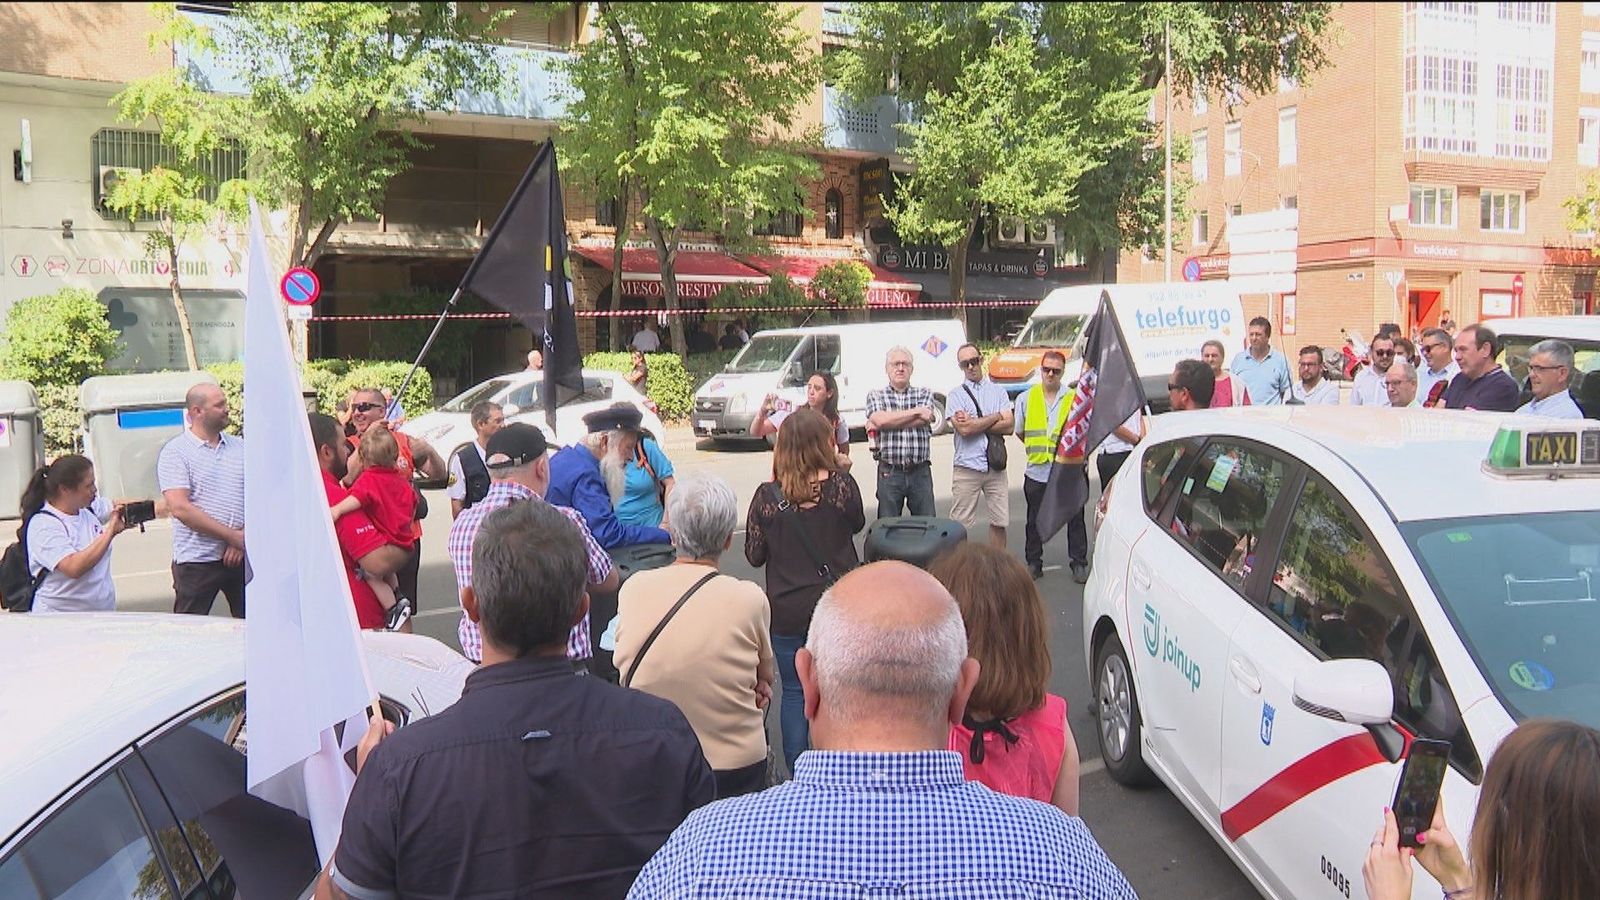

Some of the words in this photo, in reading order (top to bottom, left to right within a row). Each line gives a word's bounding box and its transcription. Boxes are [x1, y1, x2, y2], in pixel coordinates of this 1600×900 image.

[905, 250, 927, 269] MI
[933, 251, 951, 270] BA
[968, 262, 992, 273] TAPAS
[1000, 264, 1028, 275] DRINKS
[1136, 305, 1231, 329] telefurgo
[1528, 436, 1575, 461] TAXI
[1163, 625, 1201, 693] joinup
[1321, 855, 1350, 899] 09095
